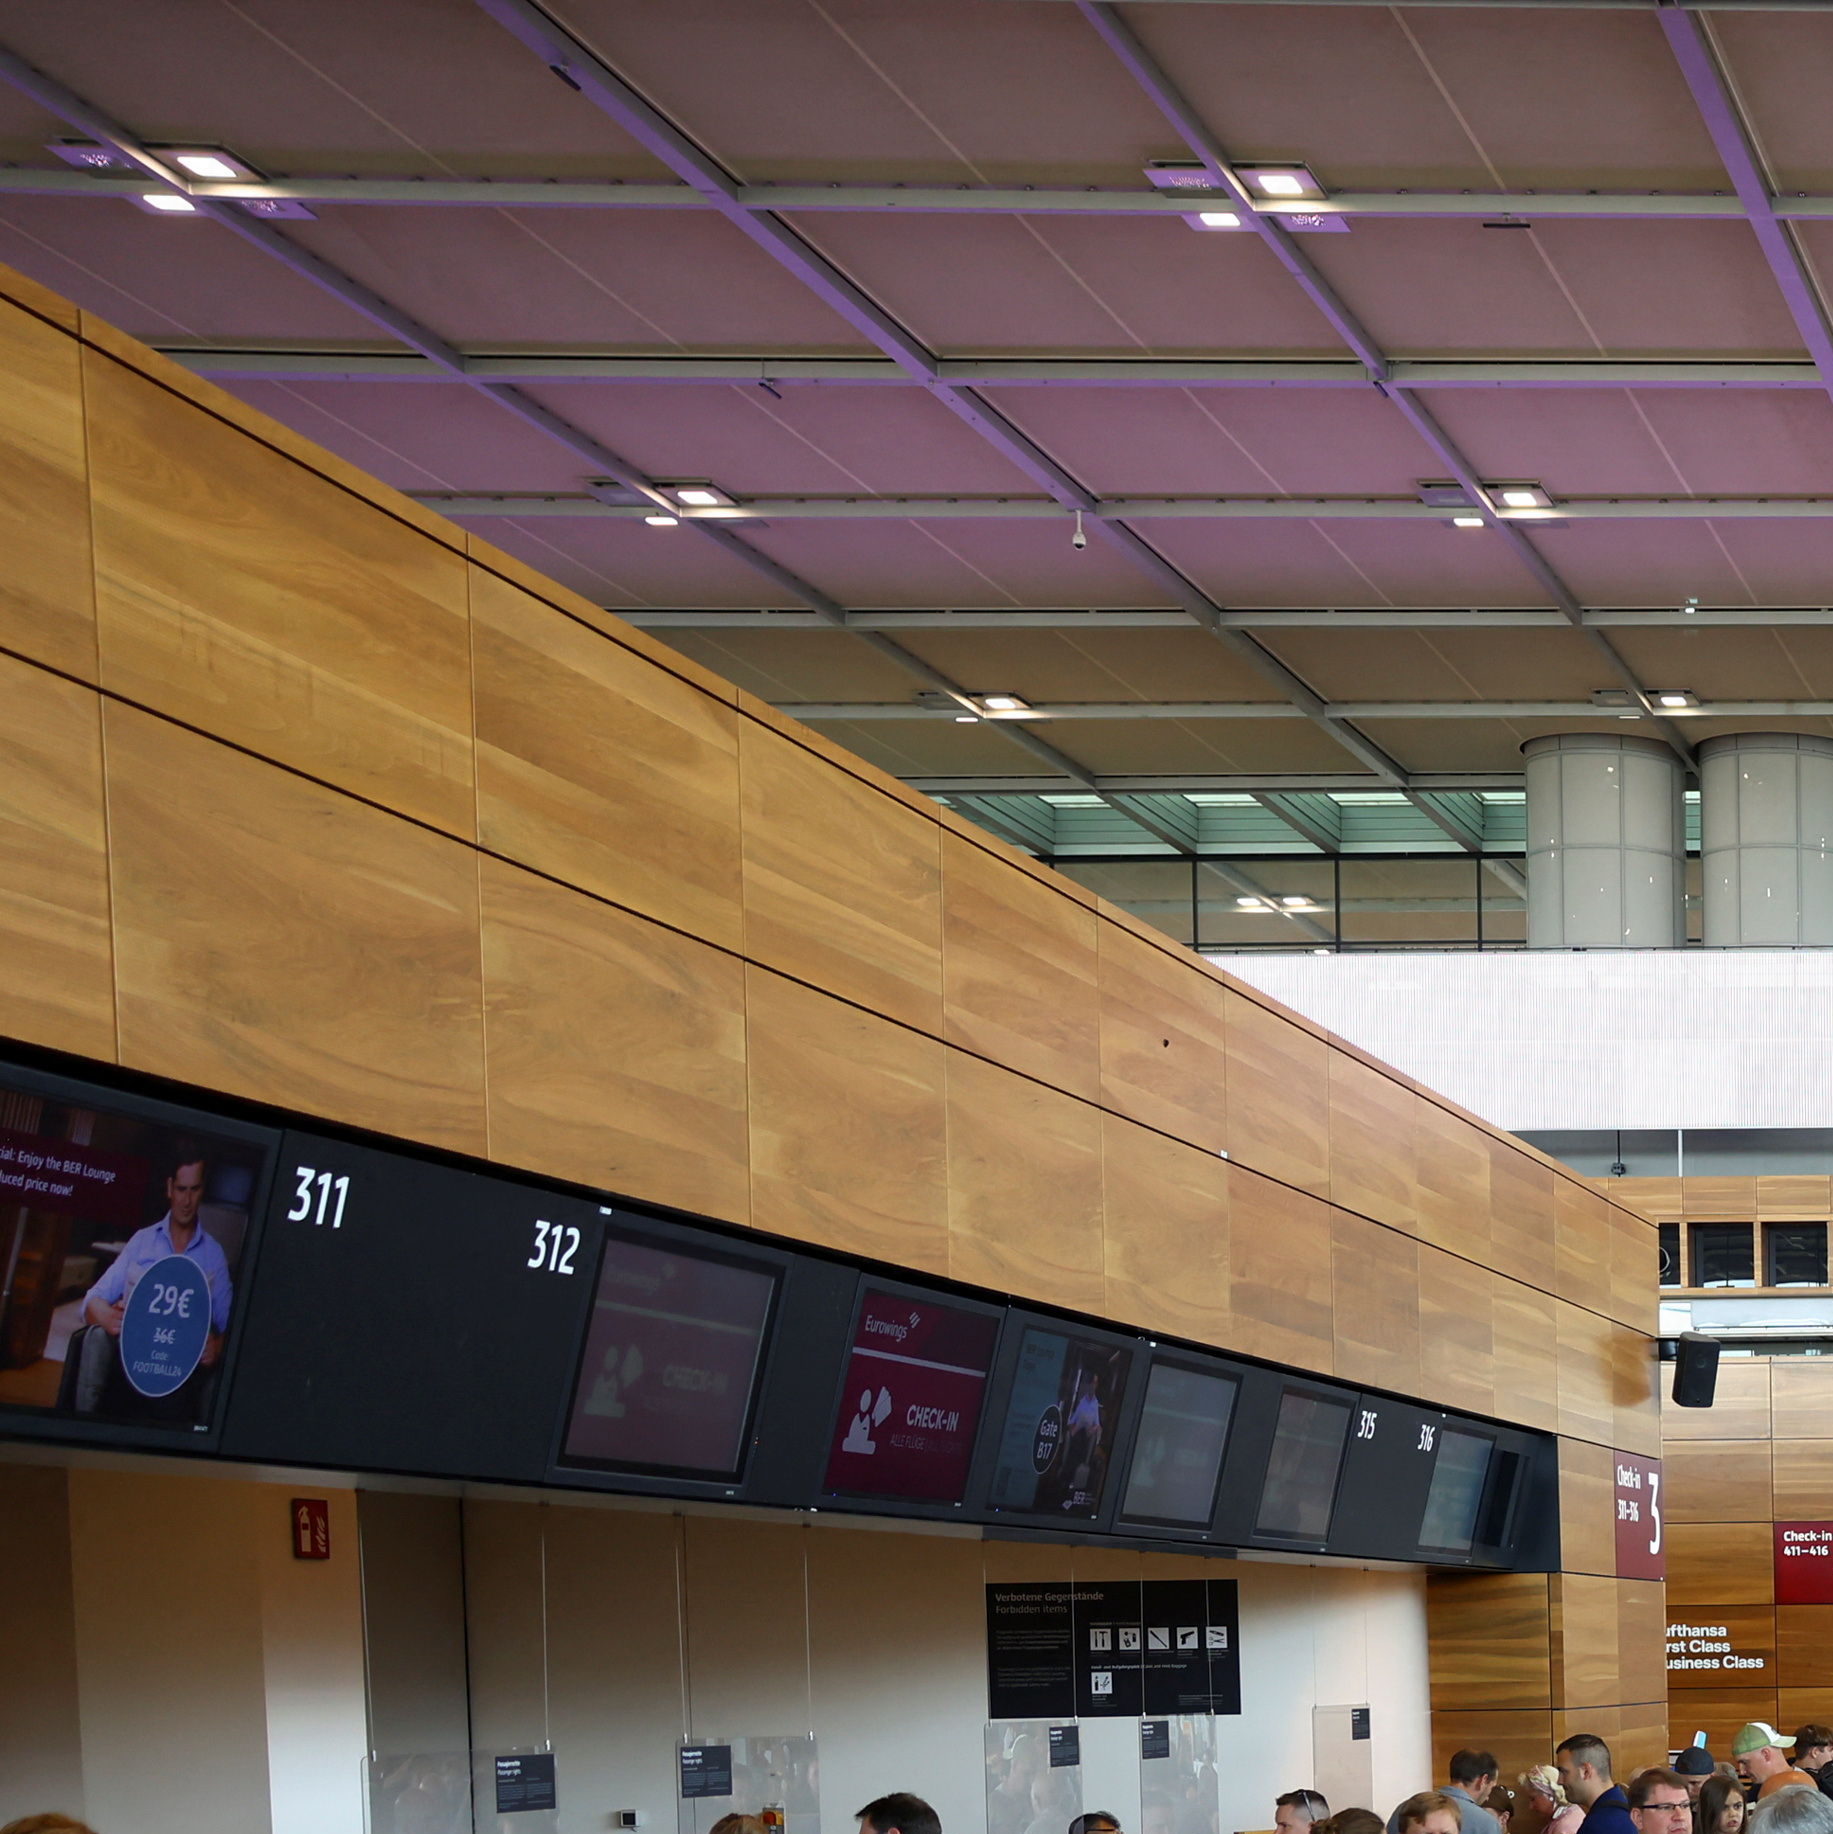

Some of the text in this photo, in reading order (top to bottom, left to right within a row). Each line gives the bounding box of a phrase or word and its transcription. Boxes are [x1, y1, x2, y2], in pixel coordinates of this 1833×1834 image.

[18, 1151, 116, 1184] Enjoy the BER Lounge
[25, 1176, 74, 1197] price now!
[286, 1166, 351, 1229] 311
[526, 1220, 582, 1275] 312
[148, 1283, 195, 1319] 29€
[153, 1327, 176, 1345] 36€
[865, 1314, 908, 1342] Eurowings
[132, 1361, 183, 1378] FOOTBALL24
[906, 1404, 960, 1432] CHECK-IN
[1357, 1410, 1378, 1440] 315
[1039, 1419, 1059, 1439] Gate
[1417, 1424, 1436, 1452] 316
[1036, 1441, 1053, 1460] B17
[1617, 1463, 1642, 1490] Check-in
[1648, 1472, 1661, 1555] 3
[1783, 1530, 1833, 1542] Check-in
[1783, 1545, 1829, 1556] 411–416
[995, 1591, 1104, 1605] Verbotene Gegenstände
[995, 1604, 1068, 1615] Forbidden items
[1666, 1623, 1727, 1637] ufthansa
[1689, 1640, 1731, 1653] Class
[1667, 1656, 1764, 1669] usiness Class
